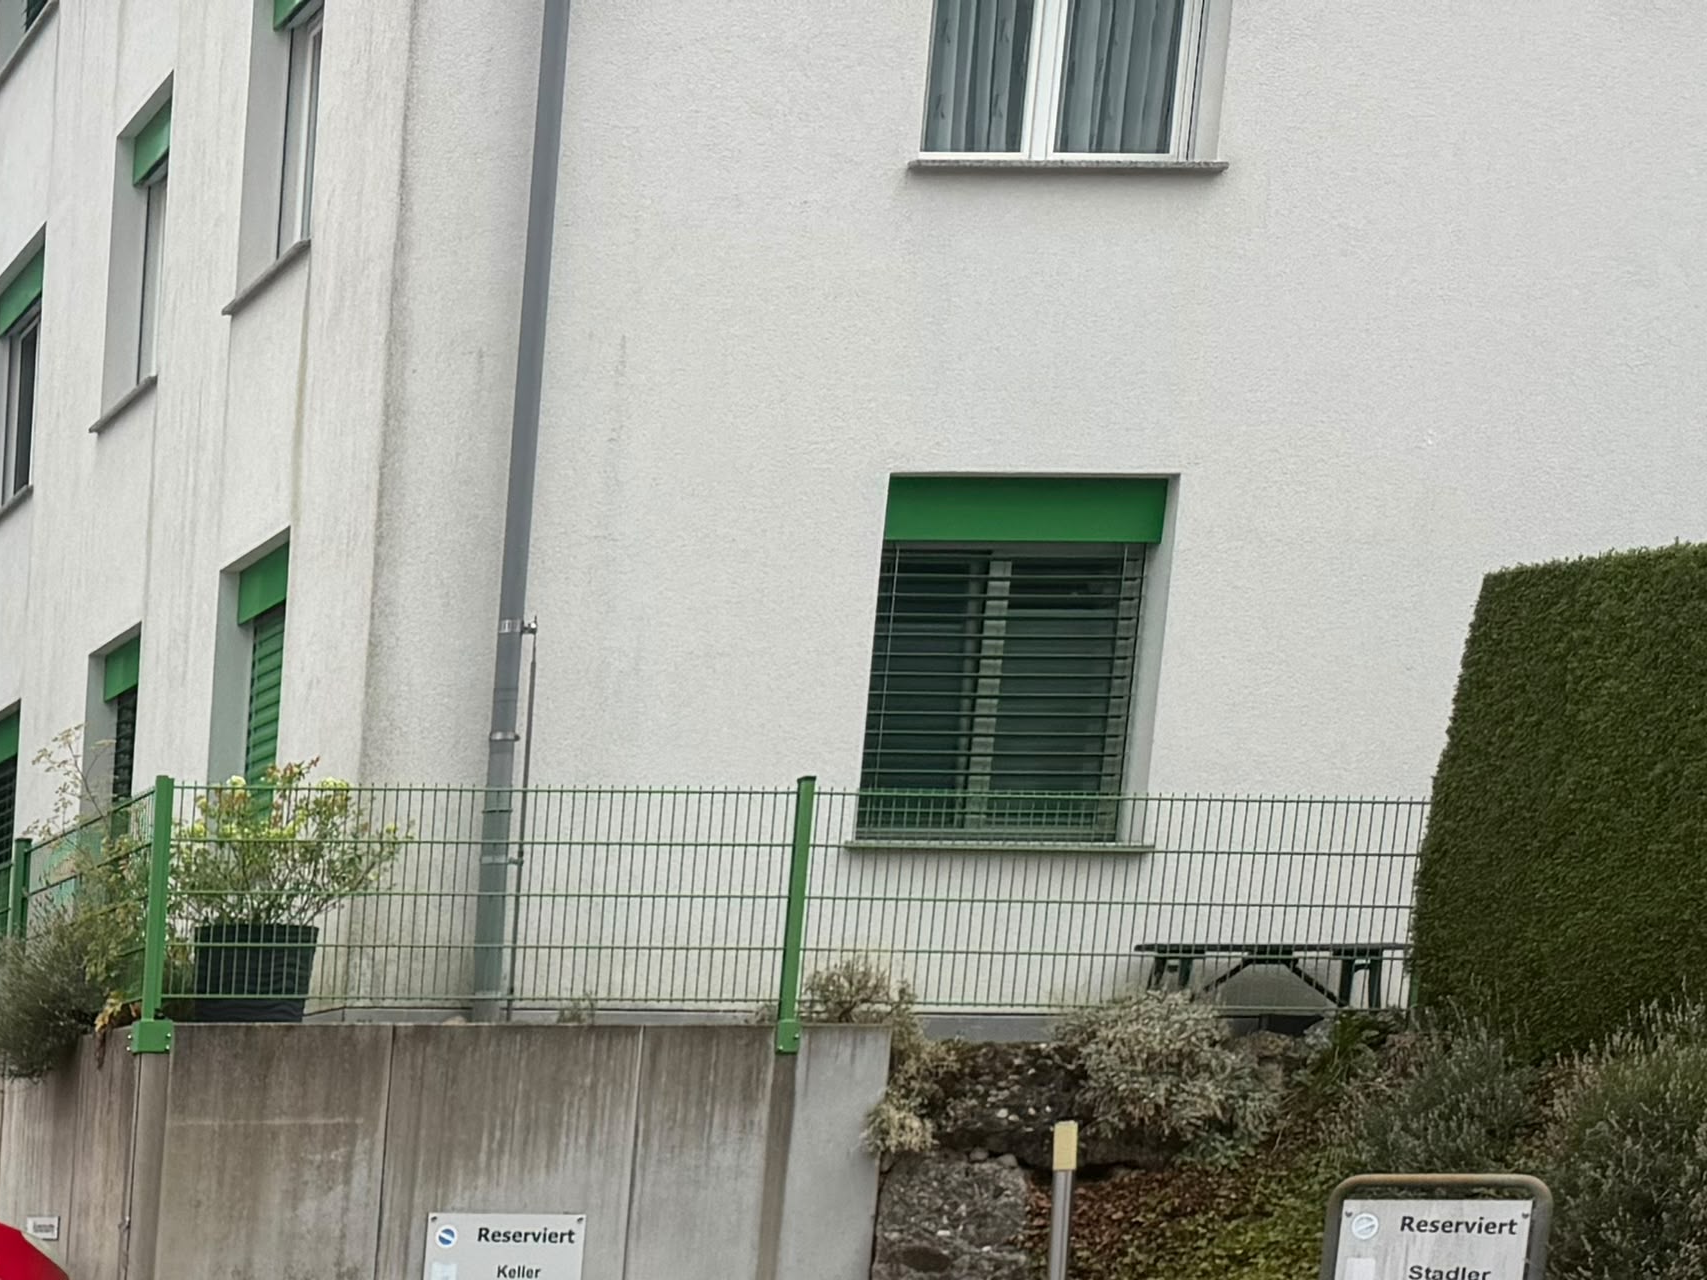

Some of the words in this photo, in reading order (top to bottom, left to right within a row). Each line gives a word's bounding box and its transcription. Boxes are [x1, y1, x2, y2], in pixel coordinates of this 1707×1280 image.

[1400, 1216, 1518, 1235] Reserviert
[477, 1227, 575, 1244] Reserviert
[496, 1265, 541, 1279] Keller
